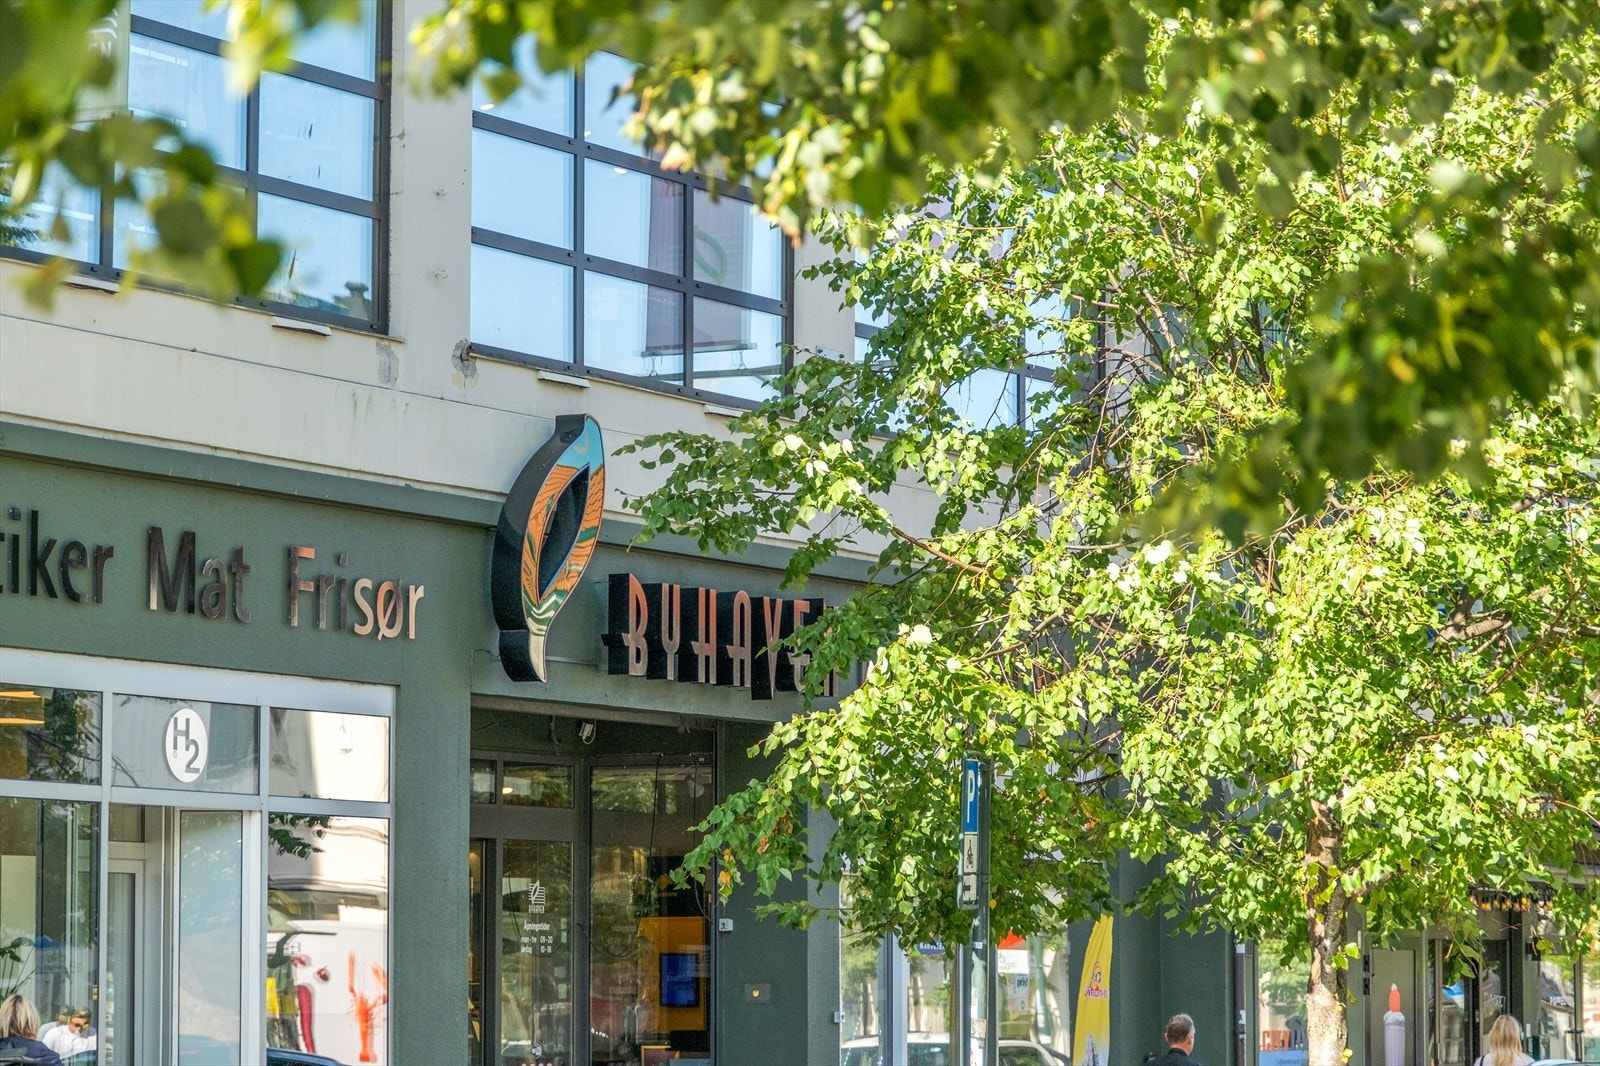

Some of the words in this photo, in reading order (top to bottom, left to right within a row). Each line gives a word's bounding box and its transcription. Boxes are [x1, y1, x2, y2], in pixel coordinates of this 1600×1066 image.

[148, 525, 252, 624] Mat
[288, 545, 425, 642] Frisør
[967, 769, 976, 823] P
